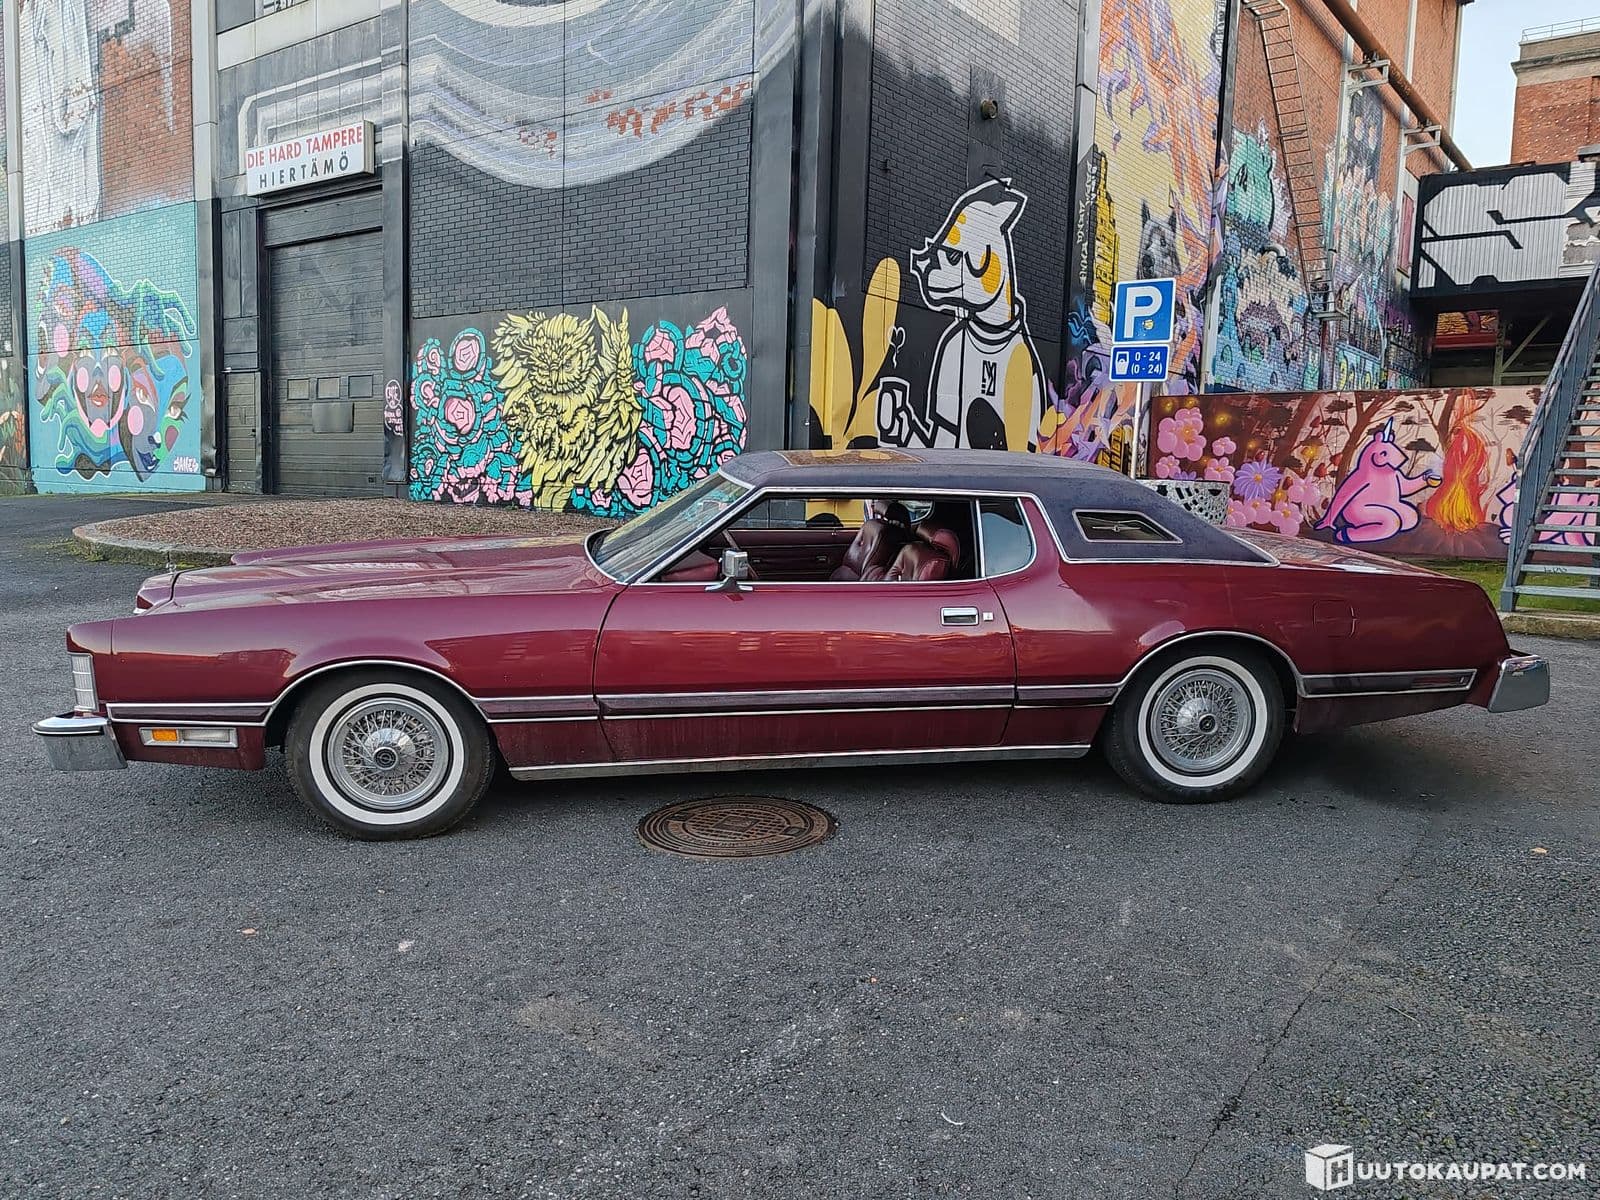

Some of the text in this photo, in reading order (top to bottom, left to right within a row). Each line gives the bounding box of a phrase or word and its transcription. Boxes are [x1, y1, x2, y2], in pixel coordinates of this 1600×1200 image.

[247, 125, 363, 169] DIE HARD TAMPERE
[259, 150, 349, 189] HIERTÄMÖ
[1123, 285, 1163, 339] P
[1148, 351, 1161, 362] 24
